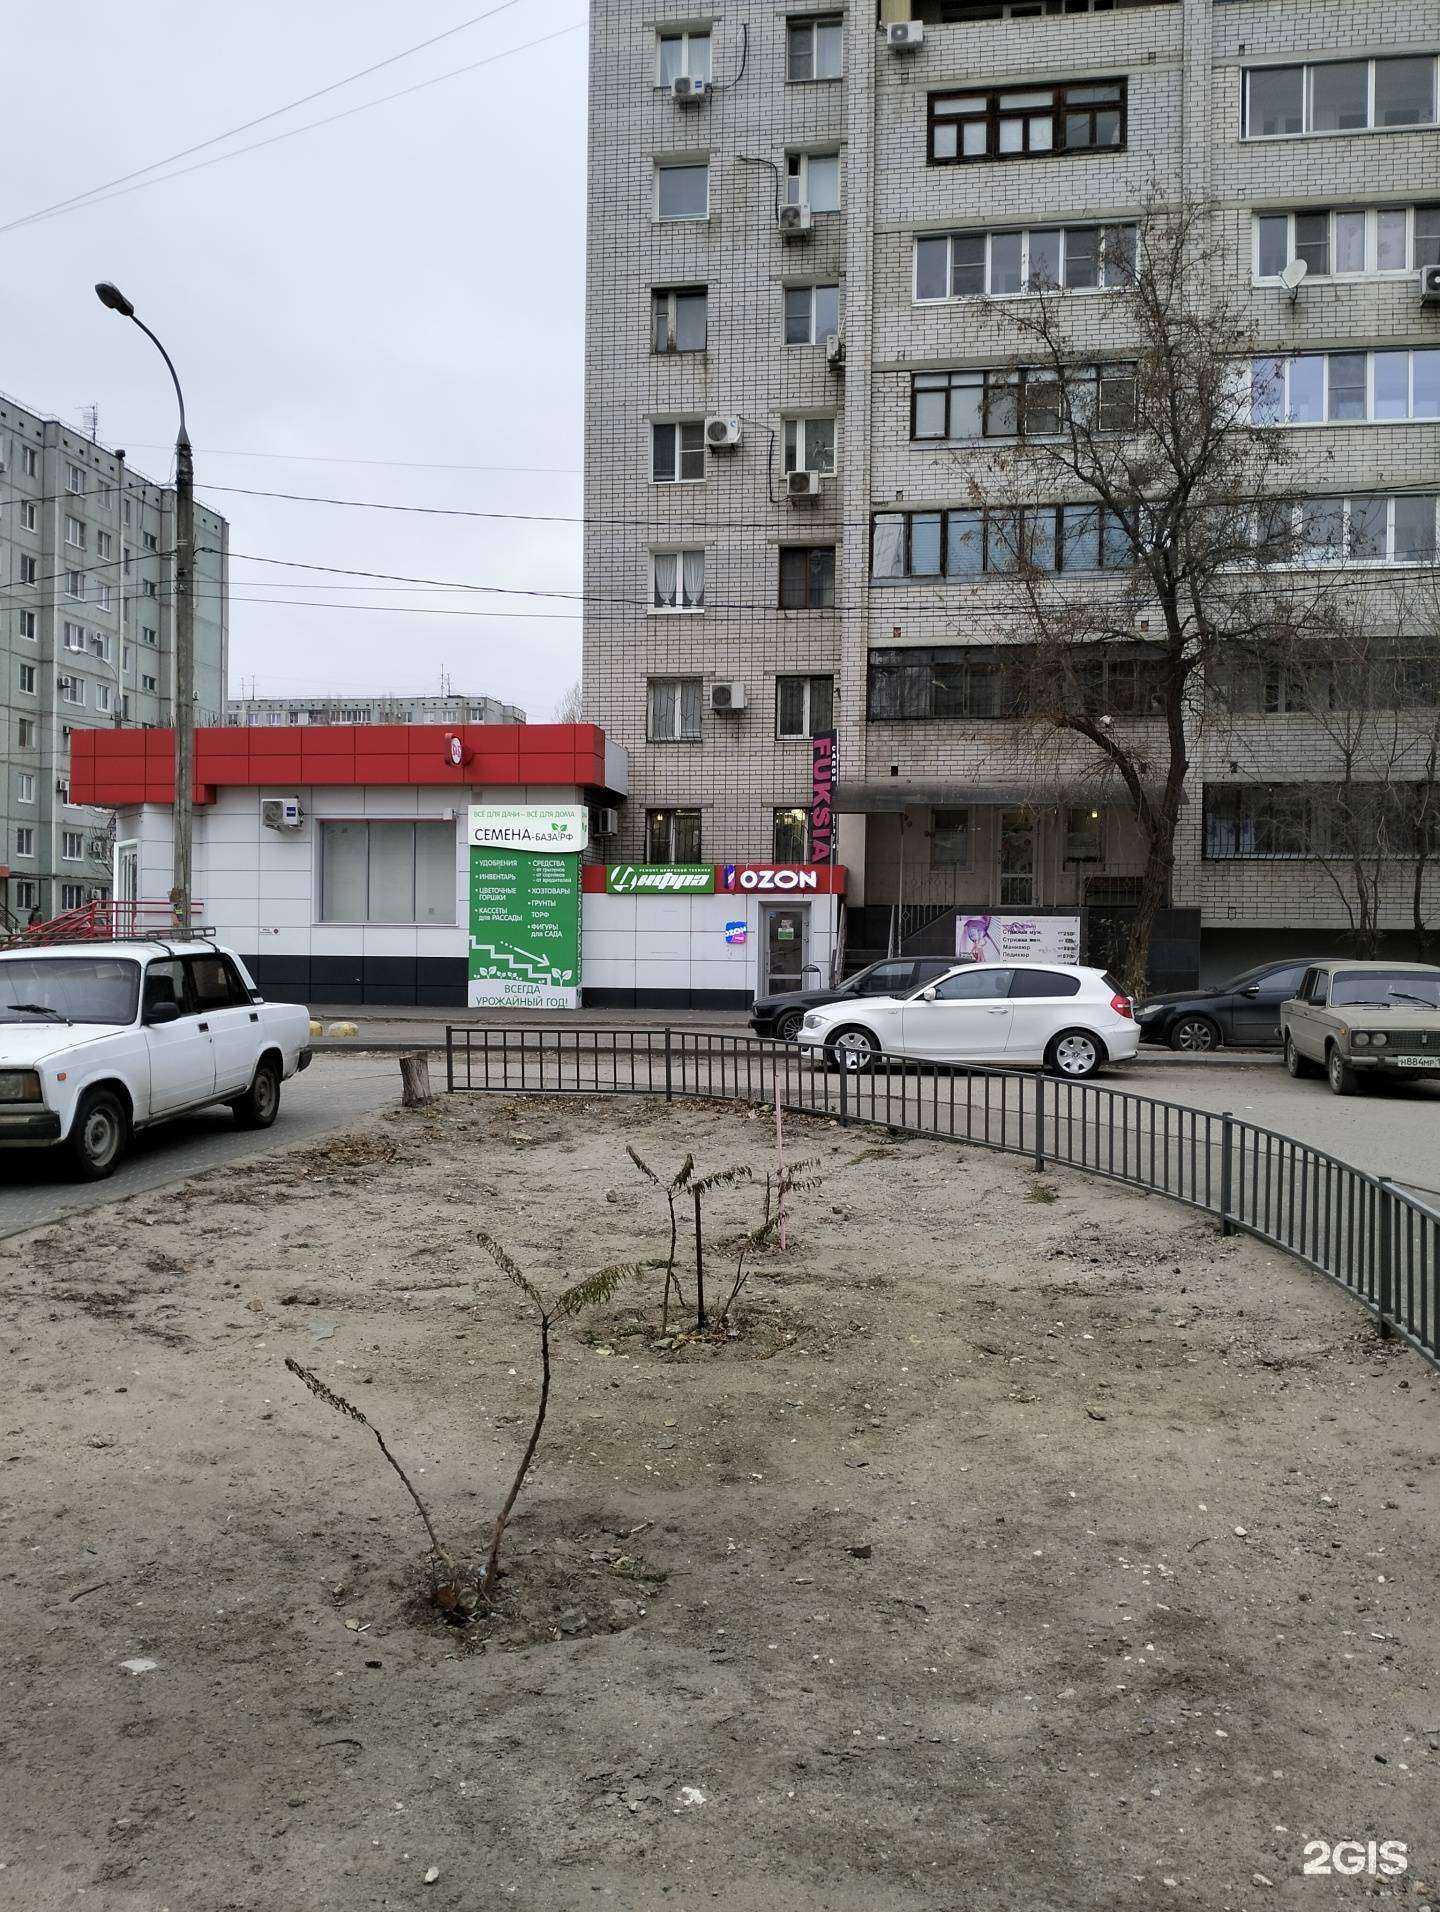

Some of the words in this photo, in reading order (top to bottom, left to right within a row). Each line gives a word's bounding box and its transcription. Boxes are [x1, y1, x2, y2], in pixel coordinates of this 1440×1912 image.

[812, 738, 832, 863] FUKSIA
[554, 810, 575, 818] ДОМА
[532, 860, 565, 868] СРЕДСТВА
[740, 870, 817, 889] OZON
[479, 887, 517, 895] ЦВЕТОЧНЫЕ
[504, 984, 541, 995] ВСЕГДА
[475, 995, 543, 1007] УРОЖАЙНЫЙ
[546, 997, 568, 1007] ГОД!
